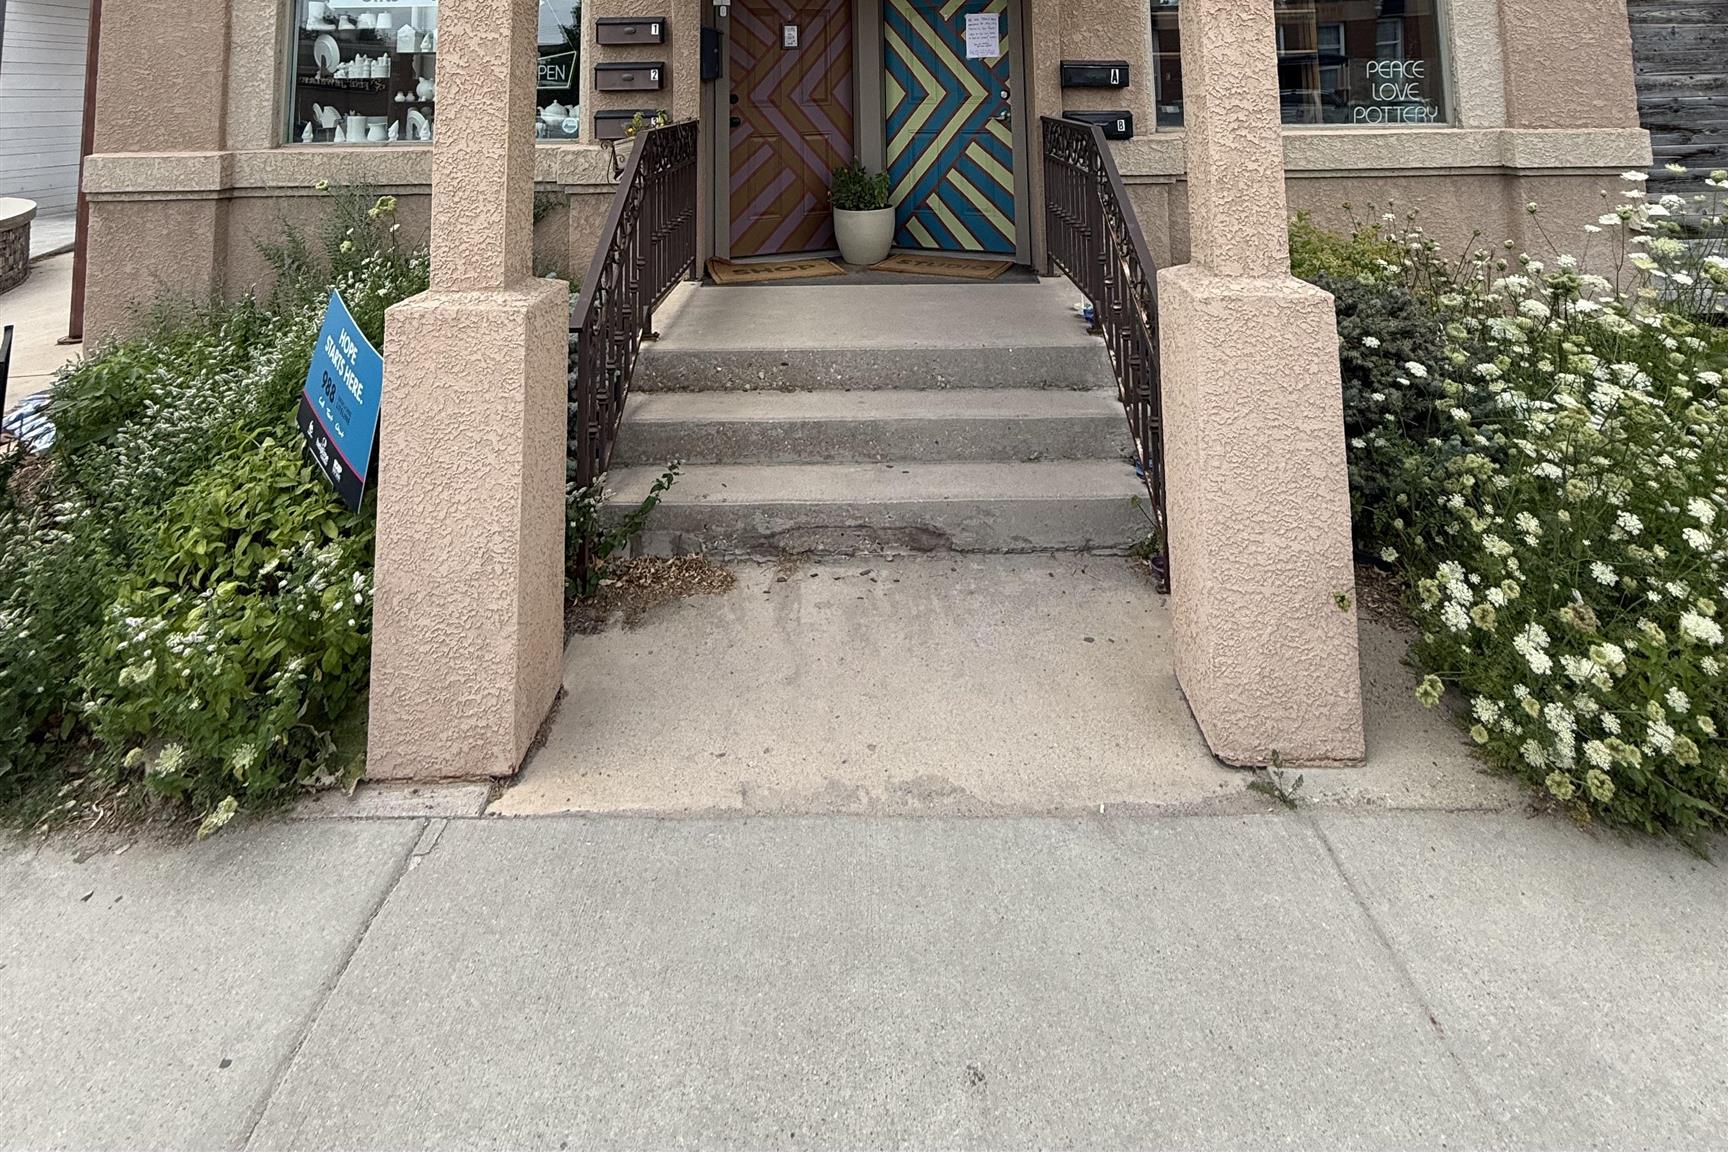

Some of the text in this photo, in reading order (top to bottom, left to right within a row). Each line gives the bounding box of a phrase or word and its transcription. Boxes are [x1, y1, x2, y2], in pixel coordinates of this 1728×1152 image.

[538, 64, 566, 80] PEN
[1366, 60, 1424, 79] PEACE
[1372, 82, 1420, 101] LOVE
[1353, 106, 1438, 124] POTTERY
[732, 264, 816, 275] SHOP
[896, 259, 990, 271] STUDIO
[339, 328, 358, 365] HOPE
[324, 334, 346, 376] STARTS
[343, 365, 364, 405] HERE.
[321, 370, 336, 403] 988
